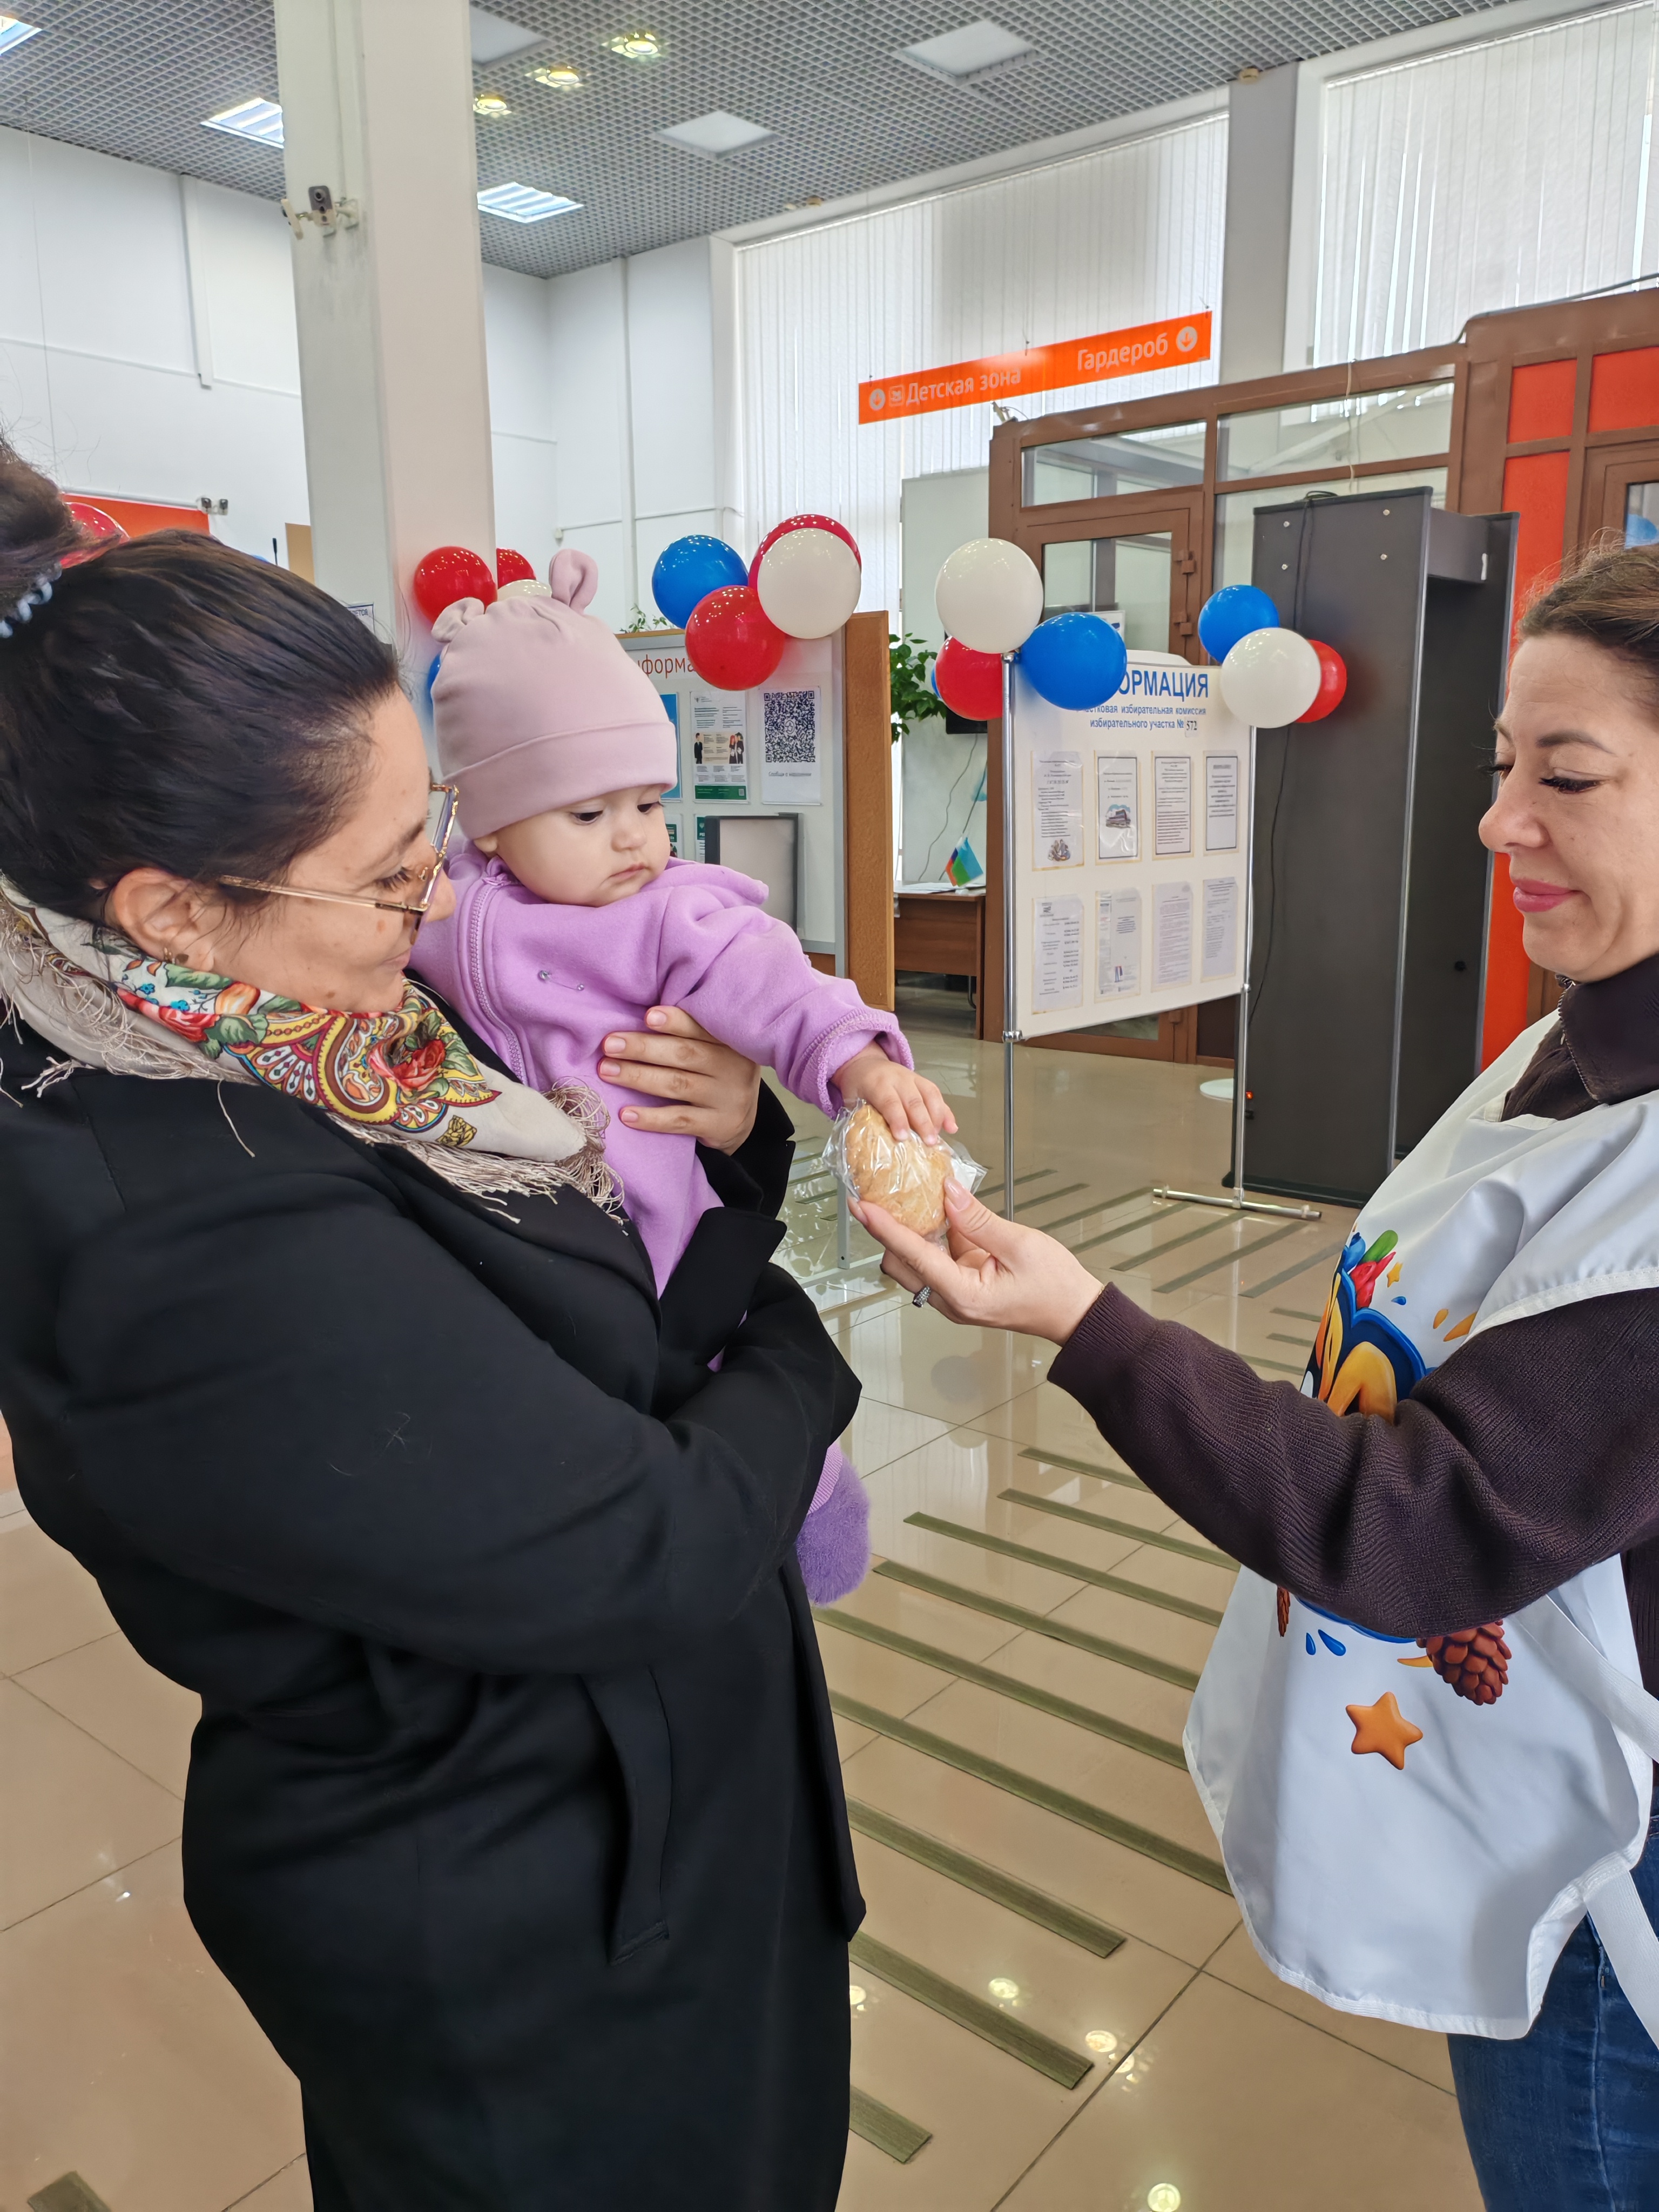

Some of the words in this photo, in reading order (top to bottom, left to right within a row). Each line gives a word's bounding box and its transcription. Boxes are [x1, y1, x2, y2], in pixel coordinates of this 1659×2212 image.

[1077, 332, 1168, 373] Гардероб
[906, 377, 974, 406] Детская
[980, 368, 1021, 391] зона
[638, 653, 694, 679] форма
[1118, 670, 1209, 702] ОРМАЦИЯ
[1090, 717, 1148, 730] избирательного
[1149, 720, 1175, 731] участка
[1121, 704, 1174, 716] избирательная
[1176, 707, 1206, 716] комиссия
